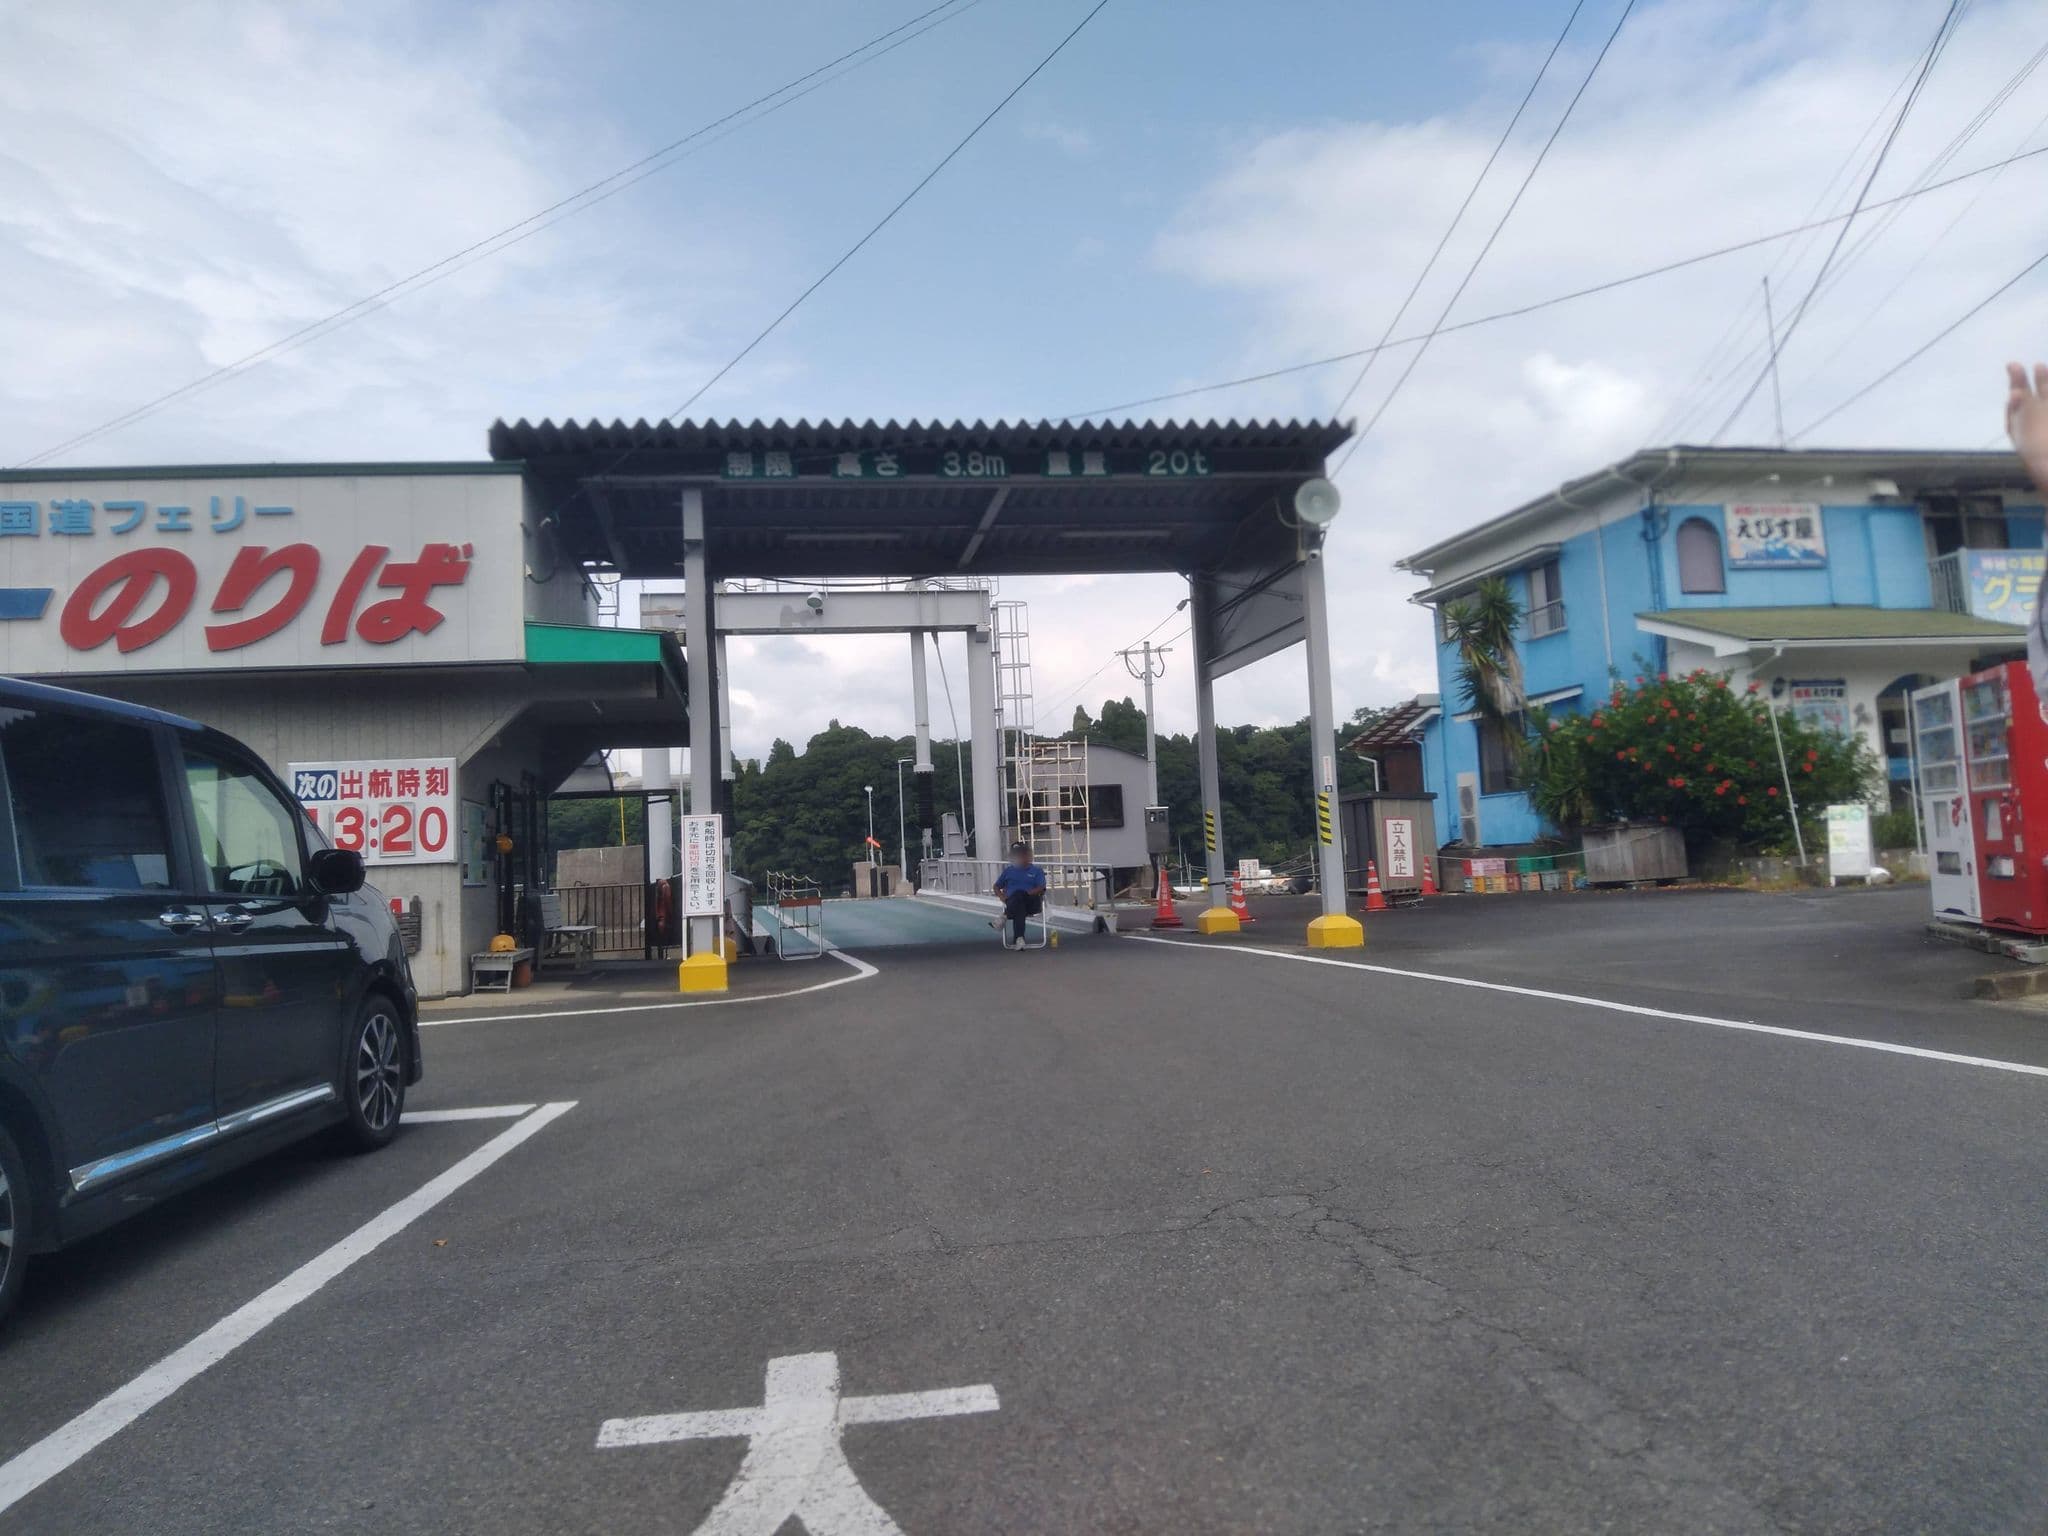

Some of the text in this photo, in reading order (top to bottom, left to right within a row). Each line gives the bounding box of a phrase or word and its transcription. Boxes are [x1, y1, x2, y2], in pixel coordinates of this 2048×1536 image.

[837, 450, 899, 476] 高さ
[944, 450, 1005, 477] 3.8m
[1148, 449, 1208, 475] 20t
[297, 767, 449, 800] 次の出航時刻
[1392, 821, 1407, 875] 立入禁止
